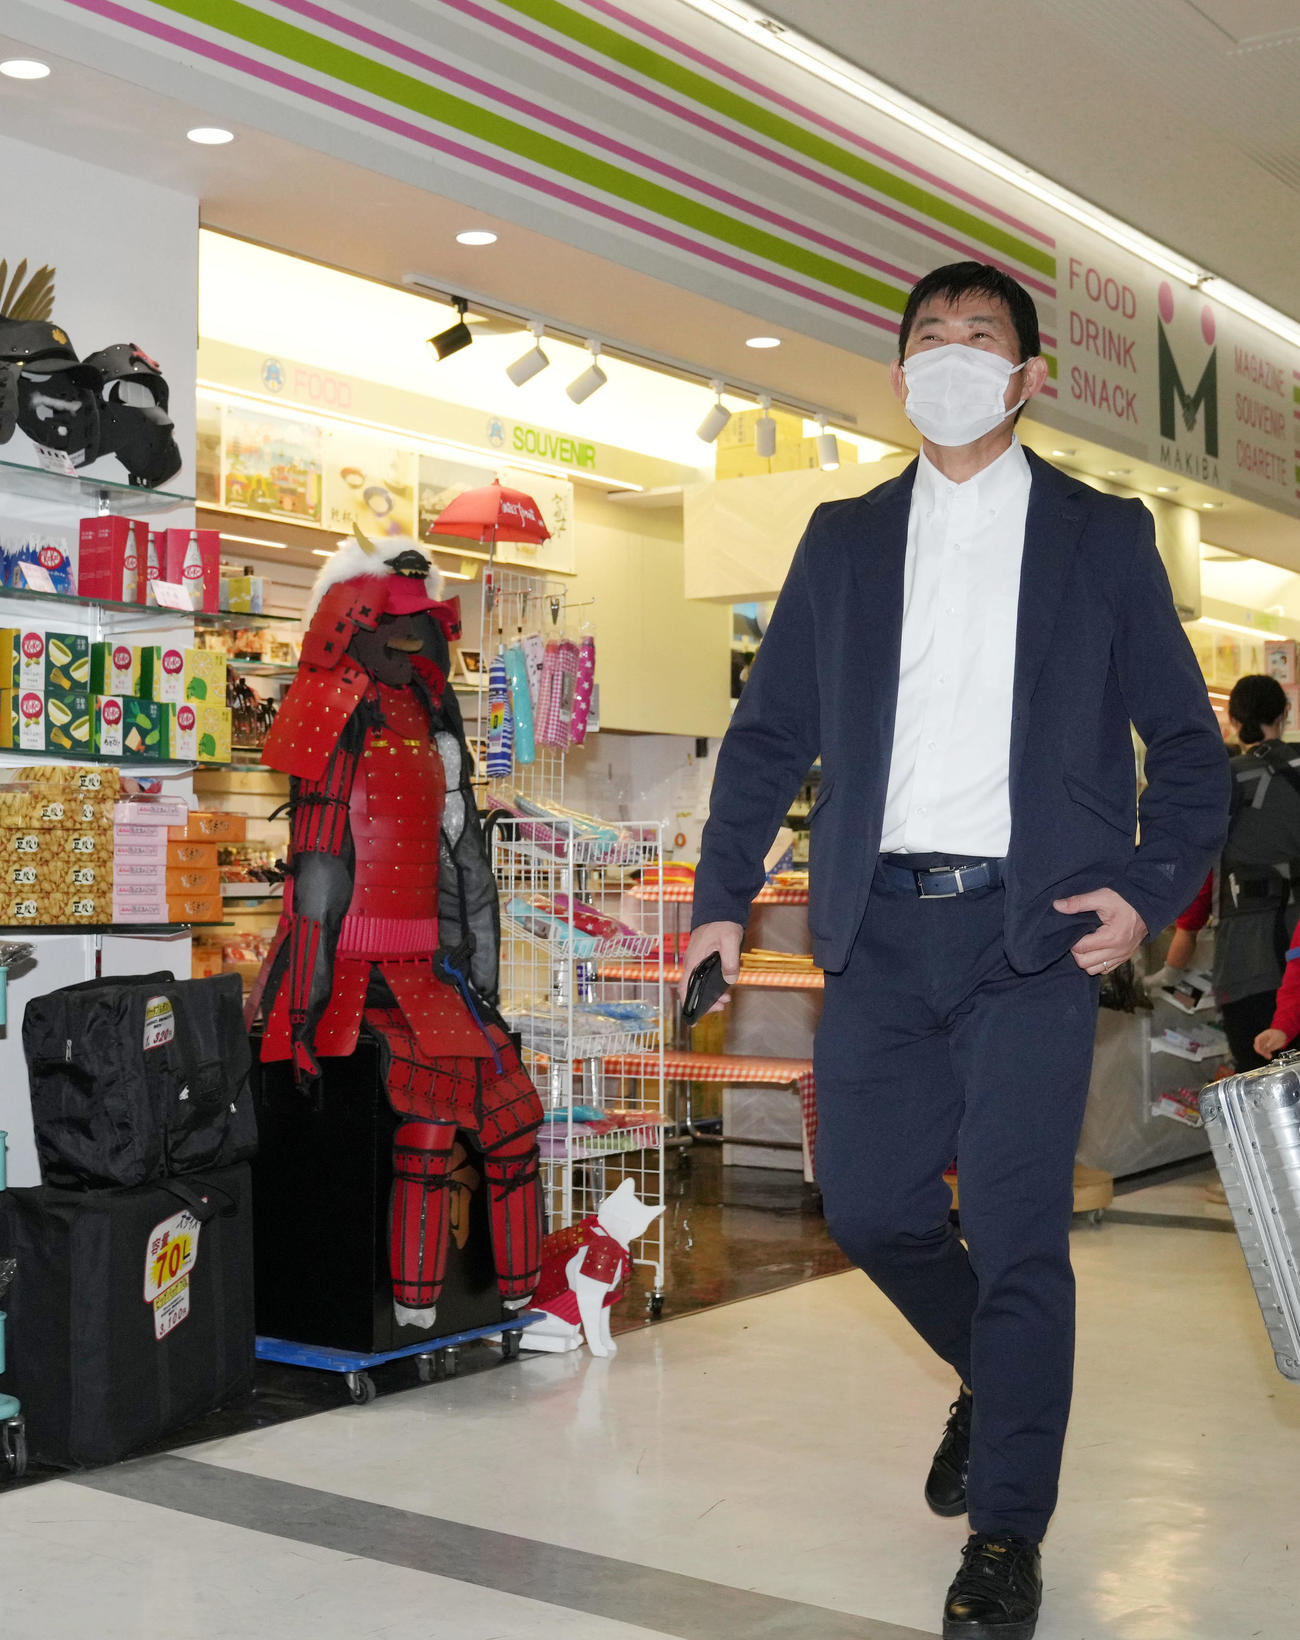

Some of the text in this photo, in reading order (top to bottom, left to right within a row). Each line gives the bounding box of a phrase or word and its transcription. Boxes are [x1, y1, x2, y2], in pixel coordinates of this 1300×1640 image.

[1069, 257, 1136, 320] FOOD
[1069, 311, 1137, 374] DRINK
[293, 367, 352, 409] FOOD
[1070, 366, 1138, 425] SNACK
[1234, 344, 1285, 398] MAGAZINE
[512, 425, 596, 470] SOUVENIR
[1160, 444, 1220, 485] MAKIBA
[1236, 439, 1288, 486] CIGARETTE
